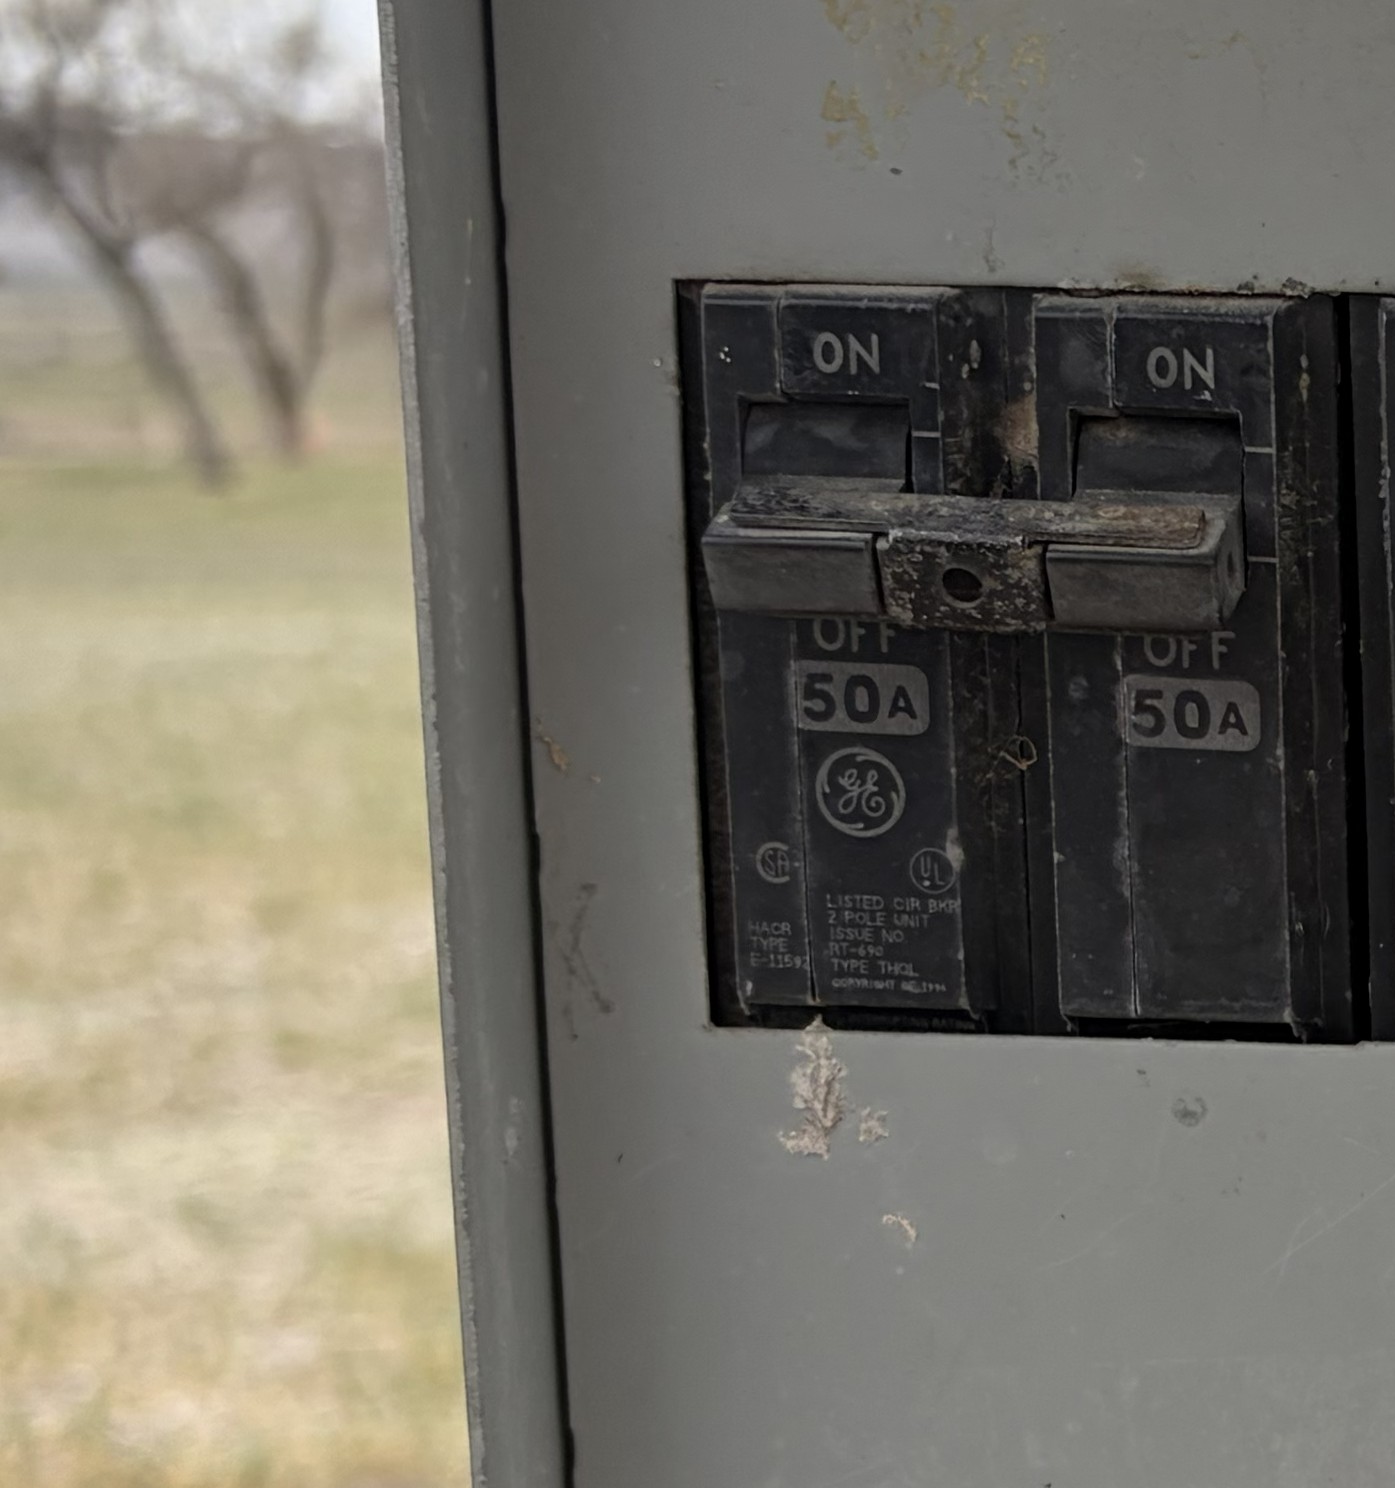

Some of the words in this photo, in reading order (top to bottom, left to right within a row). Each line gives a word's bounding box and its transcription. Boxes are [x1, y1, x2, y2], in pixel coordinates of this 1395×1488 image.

[811, 331, 881, 376] ON
[1145, 345, 1217, 393] ON
[812, 619, 896, 654] OFF
[1143, 629, 1237, 671] OFF
[803, 673, 920, 725] 50A
[1129, 688, 1250, 741] 50A
[826, 894, 884, 911] LISTED
[893, 897, 921, 912] CIR
[928, 899, 961, 914] BKR
[748, 921, 792, 936] HACR
[827, 910, 837, 924] 2
[845, 911, 886, 926] POLE
[893, 914, 931, 929] UNIT
[750, 936, 788, 952] TYPE
[829, 927, 875, 942] ISSUE
[831, 958, 869, 974] TYPE
[879, 961, 920, 977] THQL
